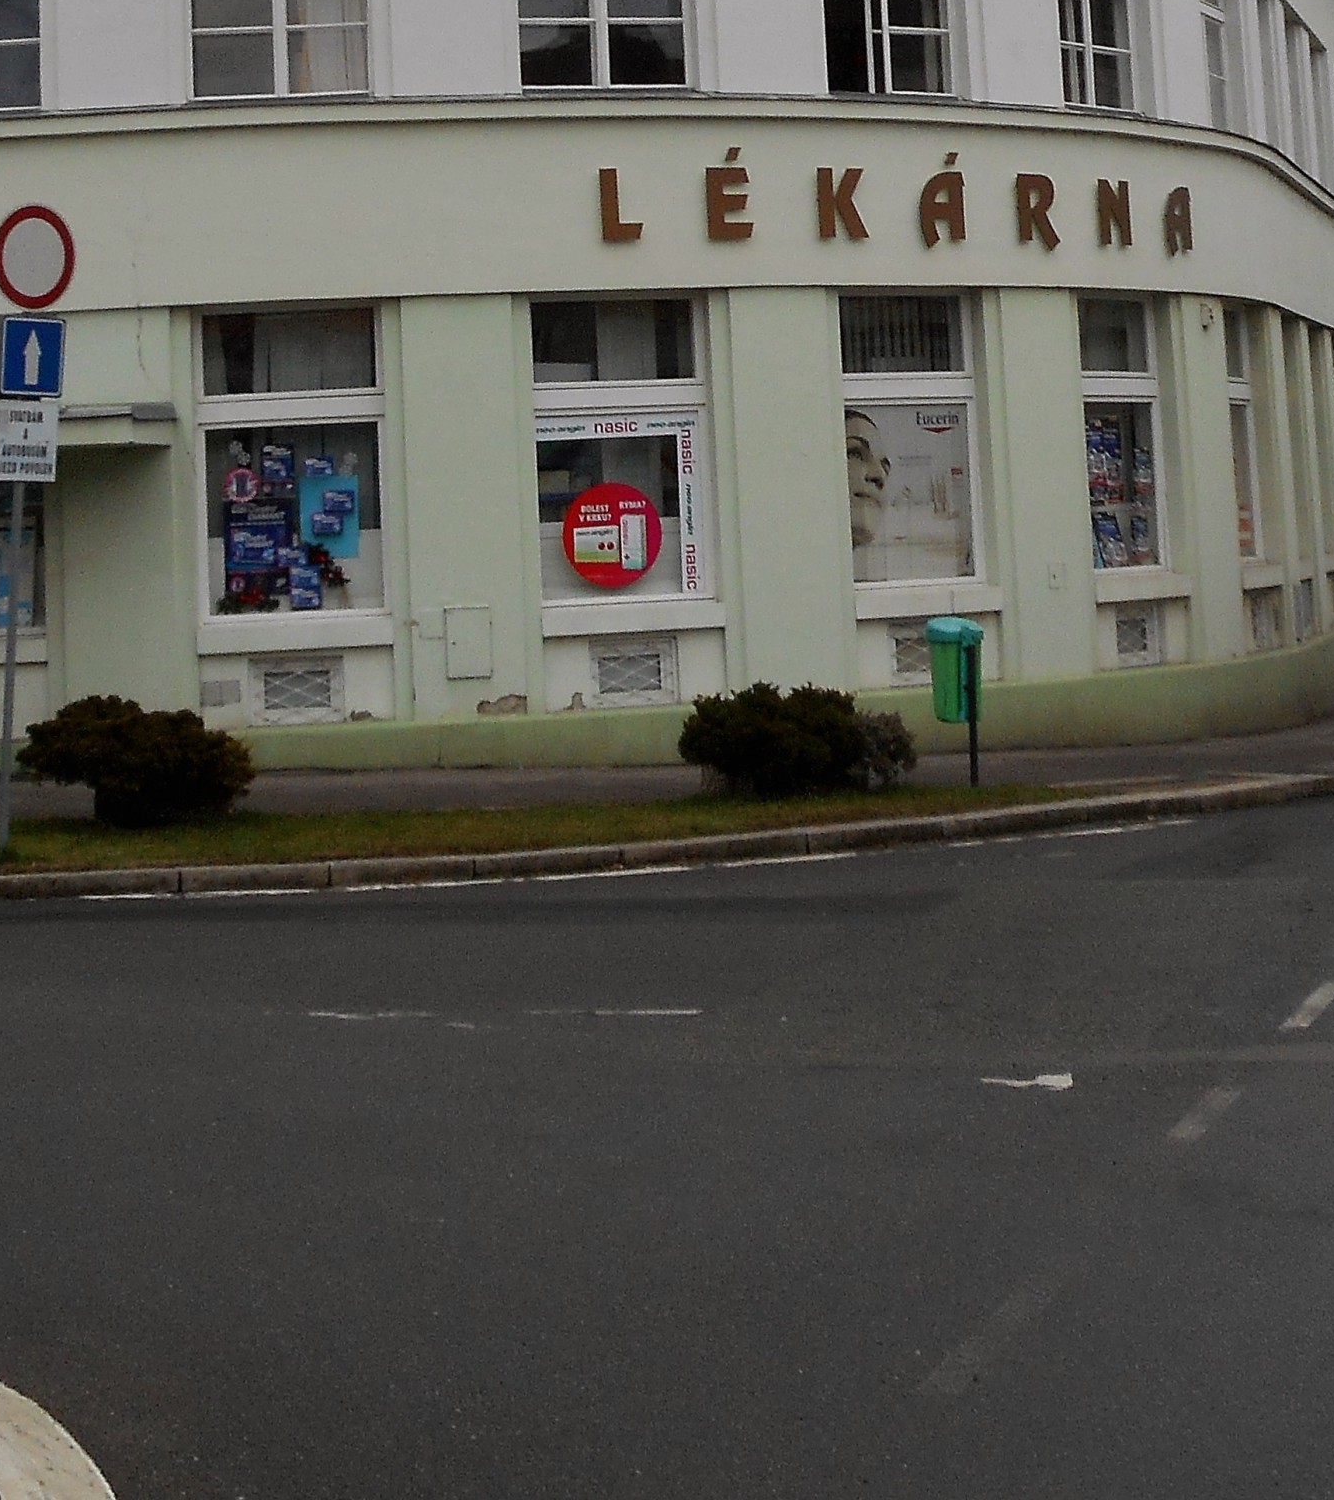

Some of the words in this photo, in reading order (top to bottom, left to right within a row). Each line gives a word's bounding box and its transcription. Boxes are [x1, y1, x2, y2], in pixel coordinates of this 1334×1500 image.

[598, 147, 1194, 257] LÉKÁRNA
[593, 417, 639, 434] nasic
[916, 411, 959, 426] Eucerin
[681, 429, 696, 475] nasic
[581, 505, 610, 514] BOLEST
[685, 543, 701, 591] nasic
